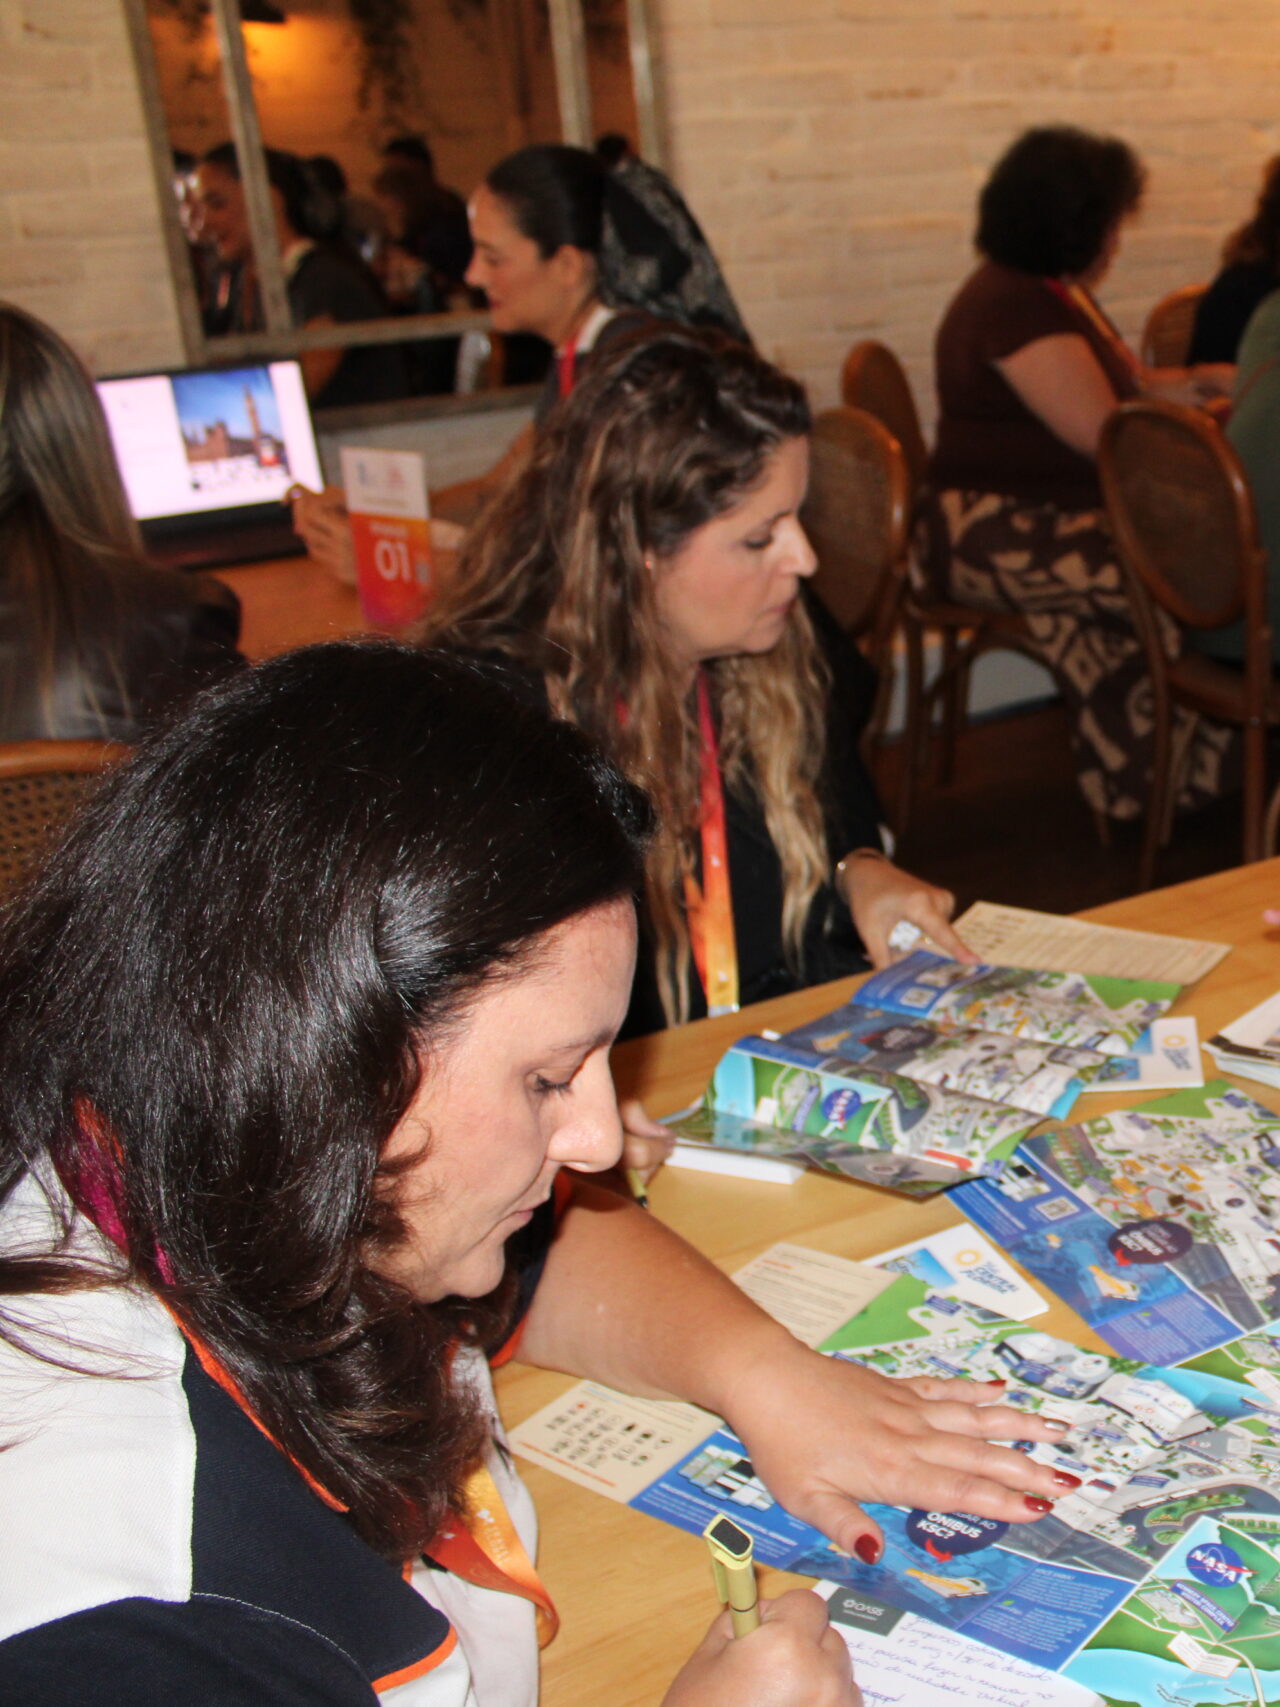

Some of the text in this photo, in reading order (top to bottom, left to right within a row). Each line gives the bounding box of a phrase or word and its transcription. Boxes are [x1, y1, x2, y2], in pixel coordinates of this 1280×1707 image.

[374, 540, 411, 582] 01
[916, 1519, 956, 1539] KSC?
[1188, 1549, 1237, 1583] NASA
